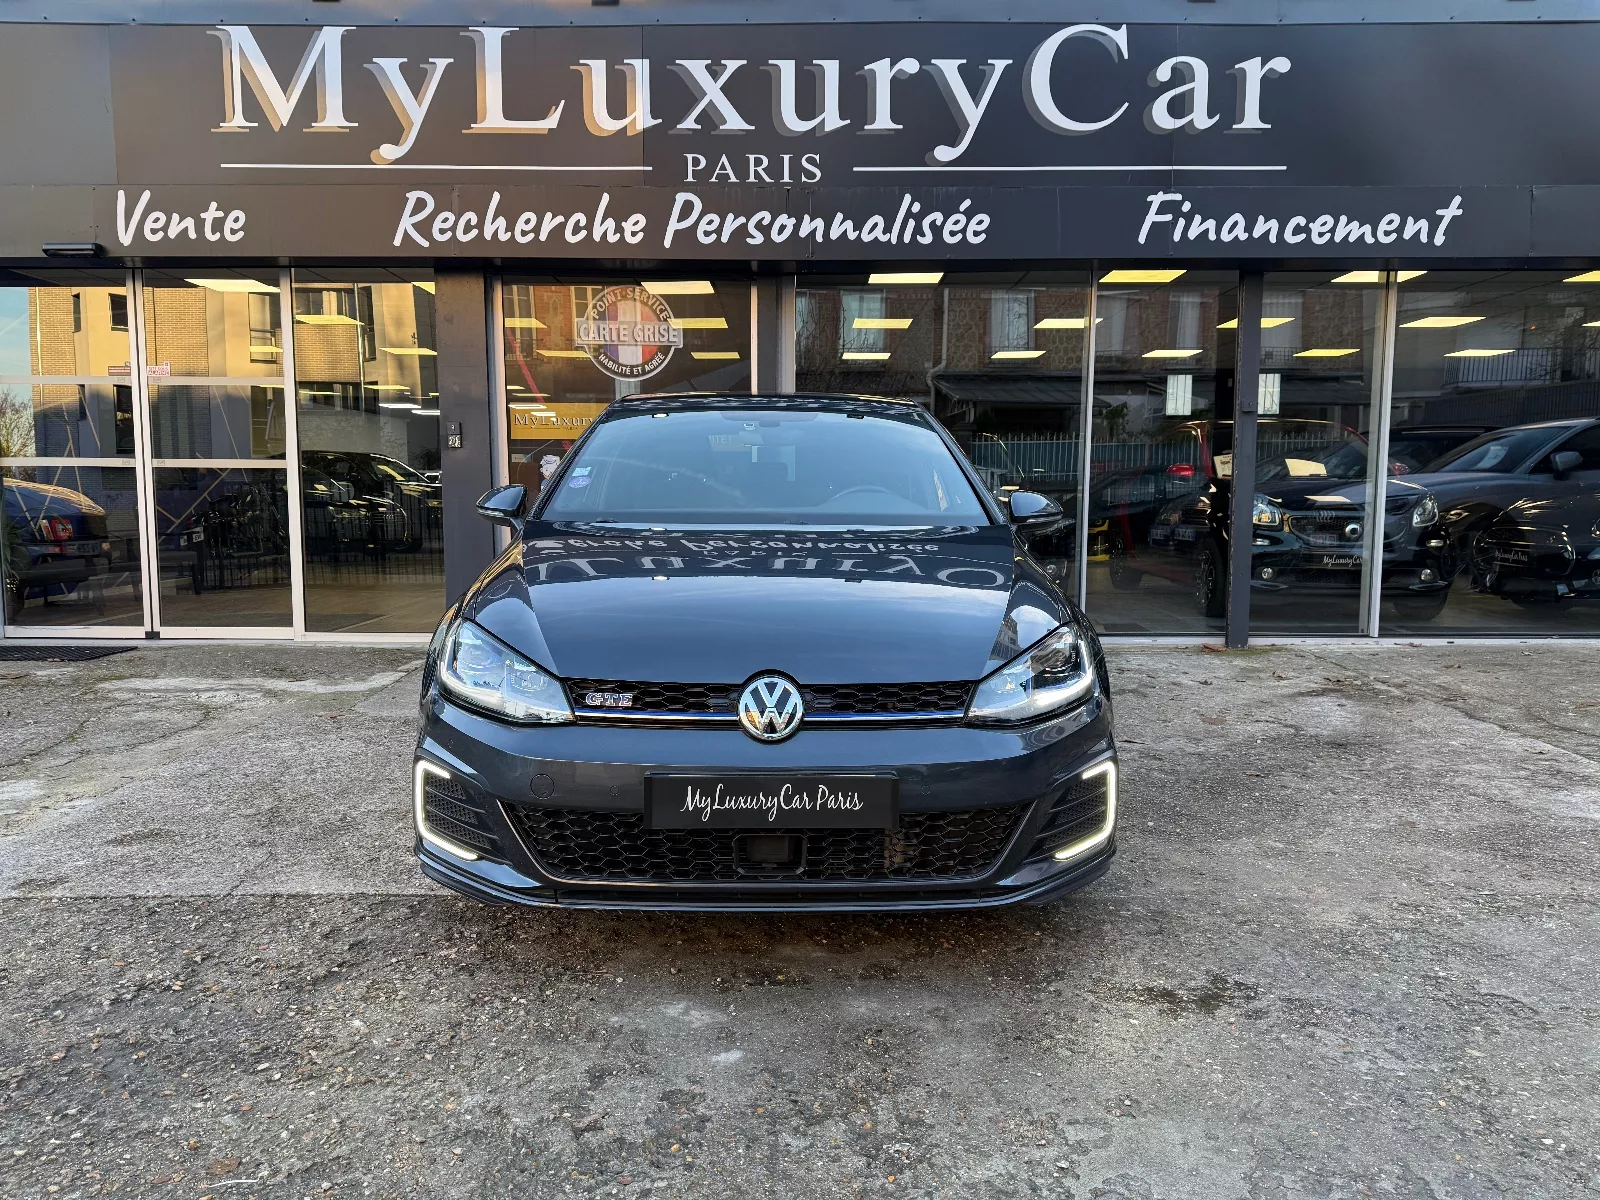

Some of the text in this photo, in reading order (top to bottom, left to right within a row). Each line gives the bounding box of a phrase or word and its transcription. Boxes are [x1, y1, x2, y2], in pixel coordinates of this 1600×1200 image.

[207, 23, 1292, 163] MyLuxuryCar
[683, 153, 823, 185] PARIS
[115, 190, 247, 247] Vente
[393, 190, 991, 249] Recherche Personnalisée
[1137, 191, 1464, 246] Financement
[591, 286, 670, 321] POINT SERVICE
[579, 323, 679, 343] CARTE GRISE
[599, 351, 666, 375] HABILITÉ ET AGRÉÉ
[585, 692, 633, 707] GTE
[679, 783, 864, 822] MyLuxuryCar Paris
